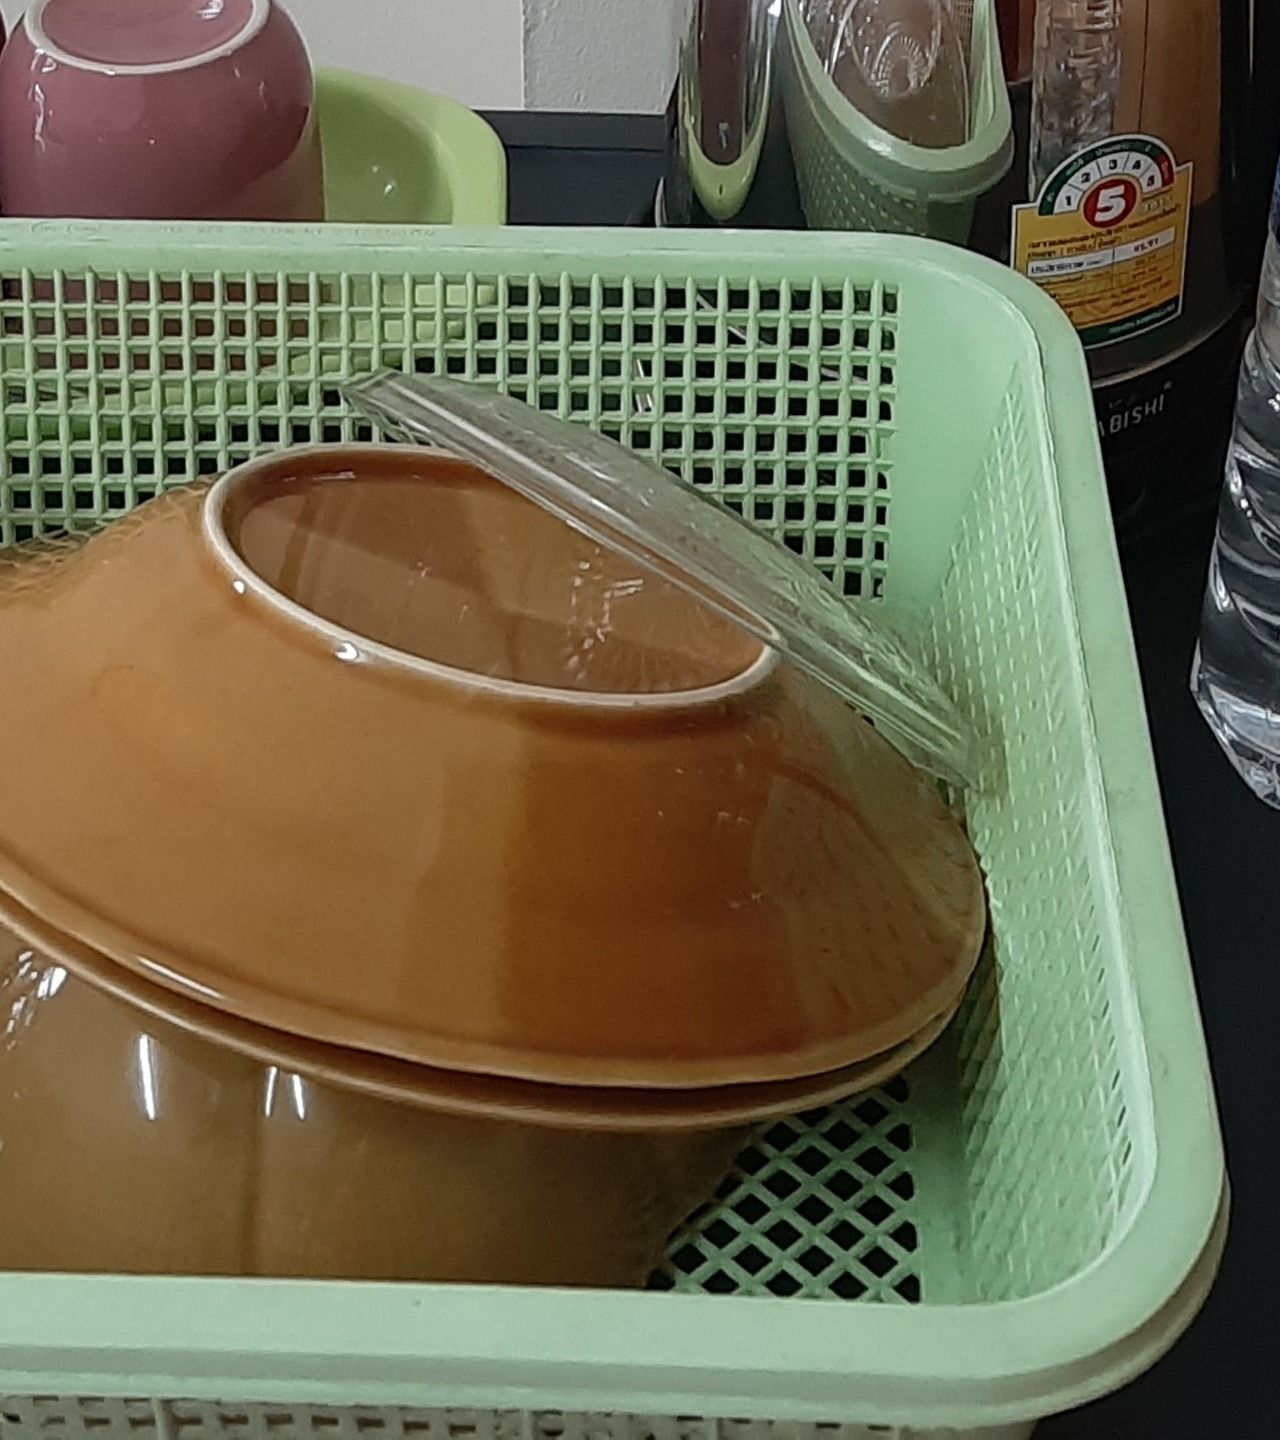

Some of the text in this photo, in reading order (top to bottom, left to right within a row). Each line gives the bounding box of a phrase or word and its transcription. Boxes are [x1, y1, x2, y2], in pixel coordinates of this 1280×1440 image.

[1064, 195, 1073, 207] 1
[1080, 171, 1092, 184] 2
[1108, 158, 1119, 171] 3
[1131, 158, 1142, 171] 4
[1093, 183, 1127, 223] 5
